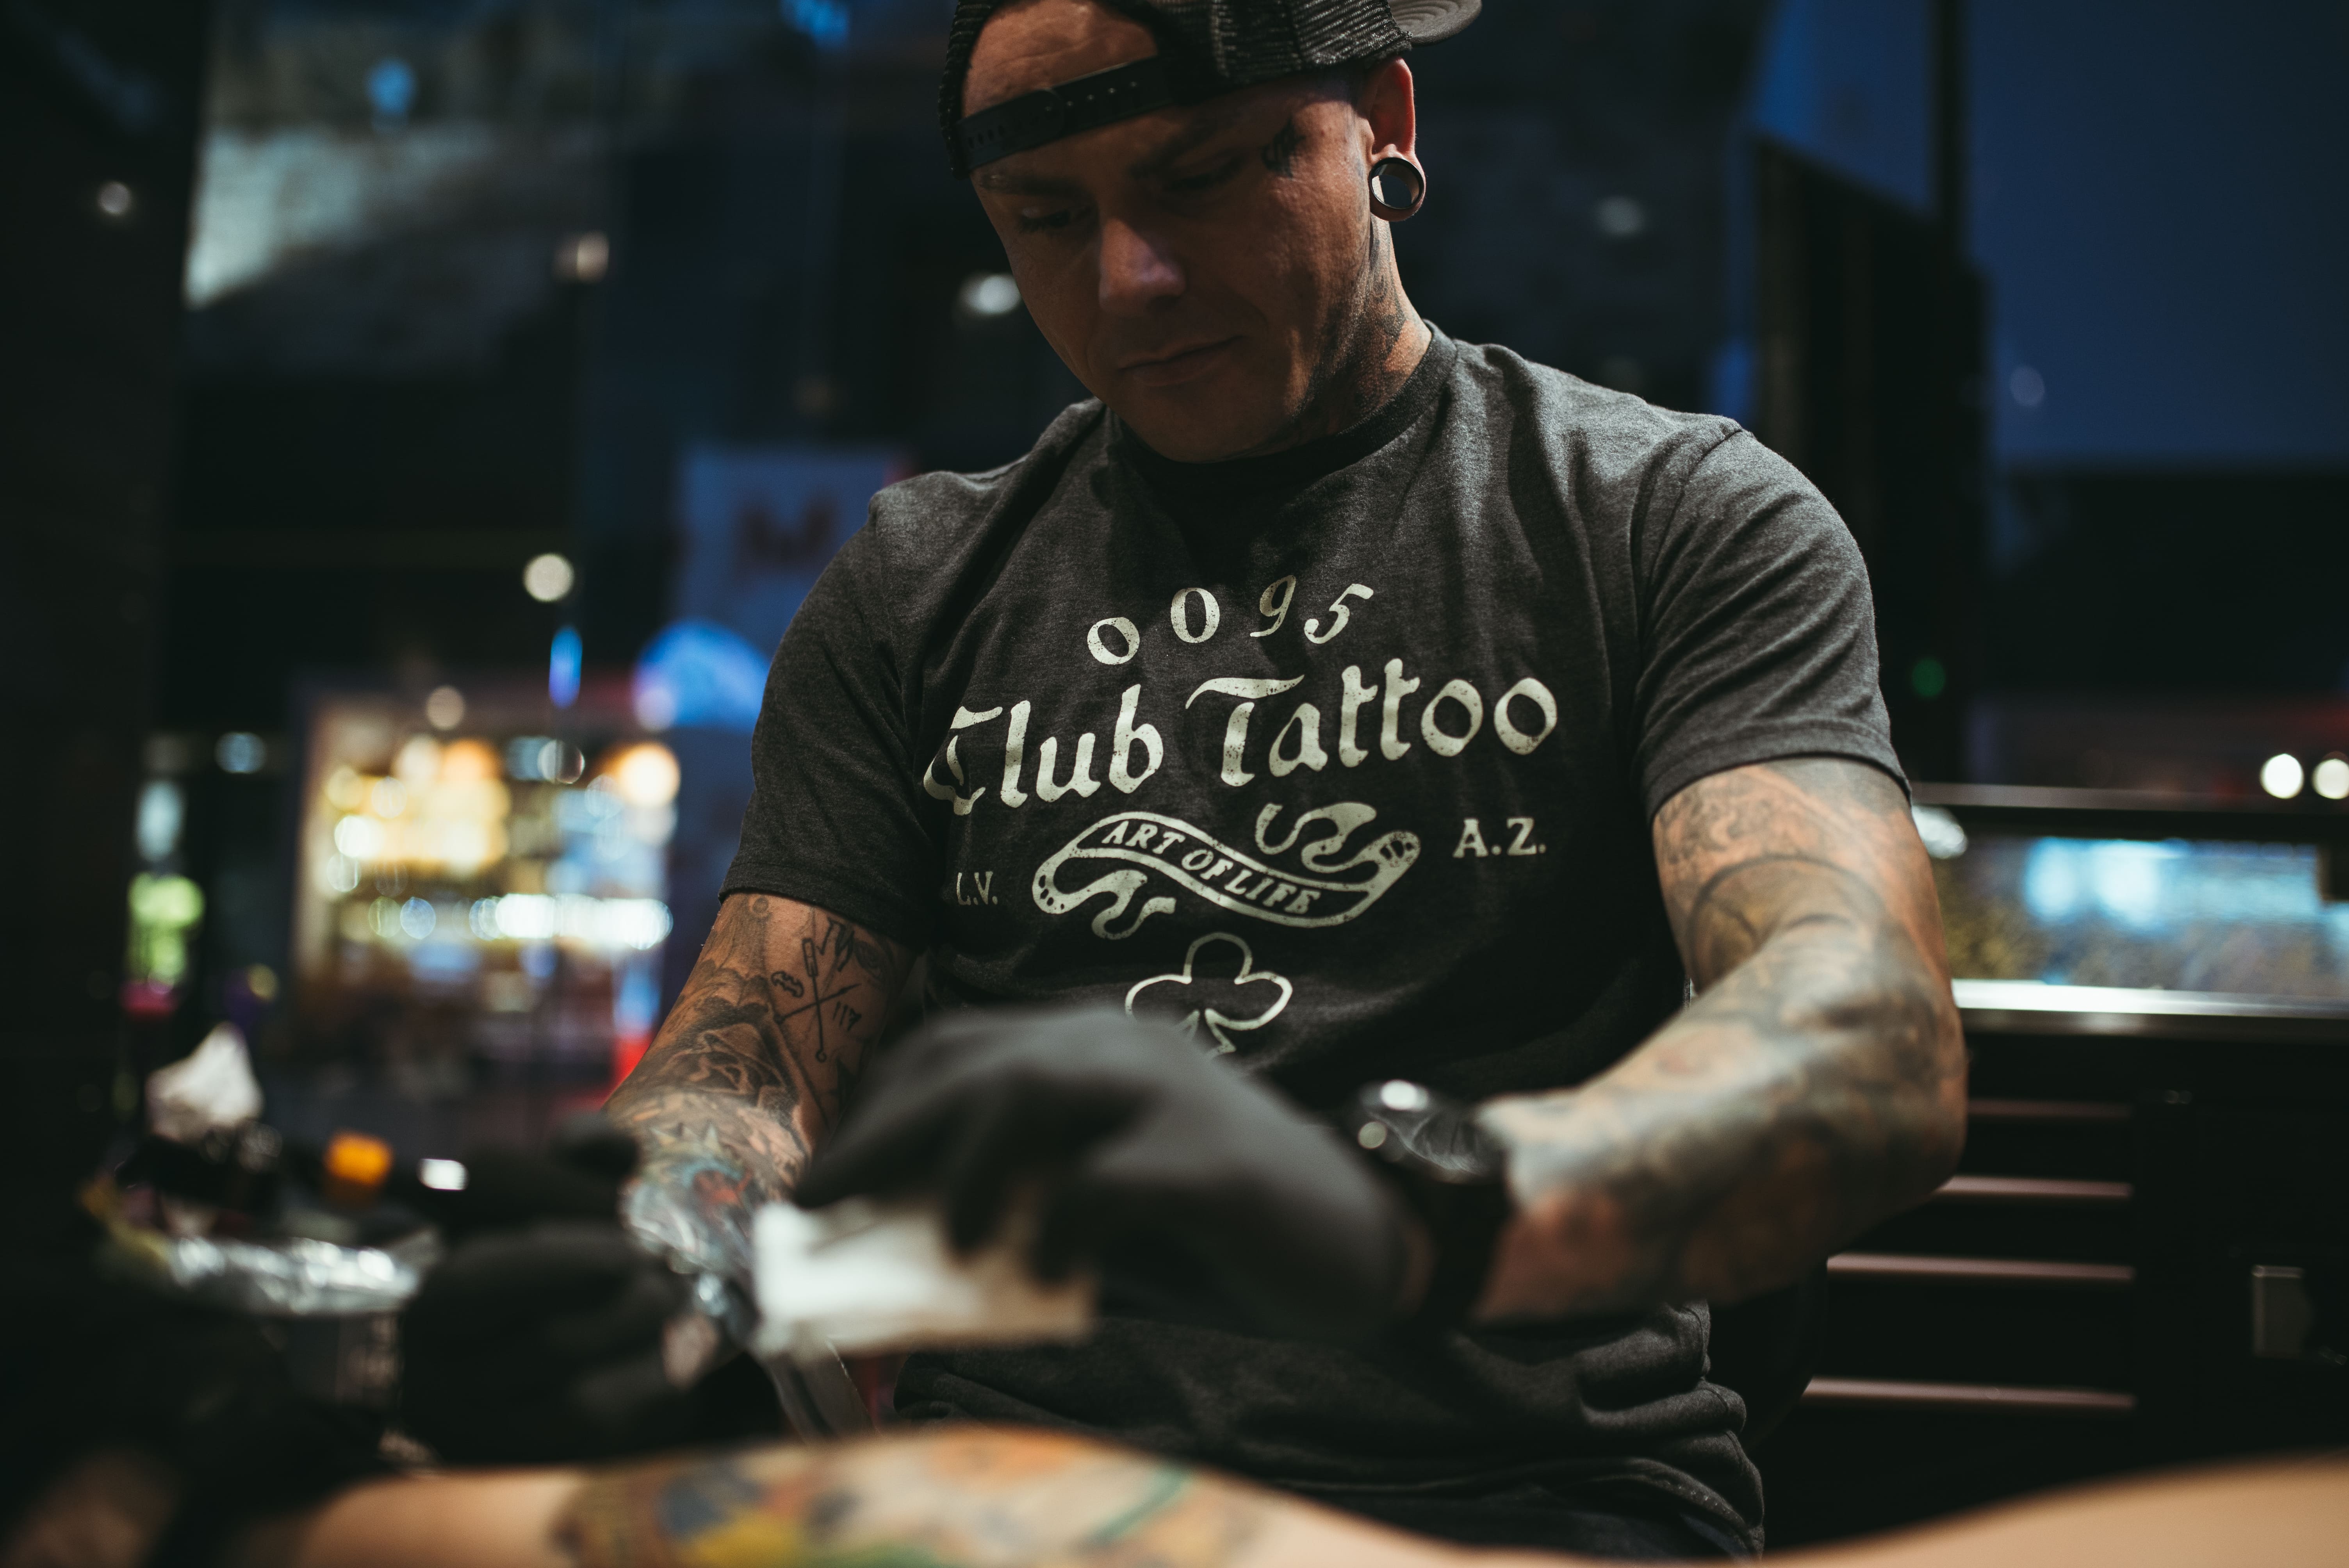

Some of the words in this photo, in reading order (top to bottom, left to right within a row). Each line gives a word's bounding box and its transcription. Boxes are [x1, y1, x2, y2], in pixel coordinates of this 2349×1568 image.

[923, 683, 1164, 815] Club
[1185, 657, 1558, 787] Tattoo
[1101, 820, 1186, 854] ART
[1181, 849, 1234, 880] OF
[1224, 869, 1321, 914] LIFE
[1452, 817, 1547, 858] A.Z.
